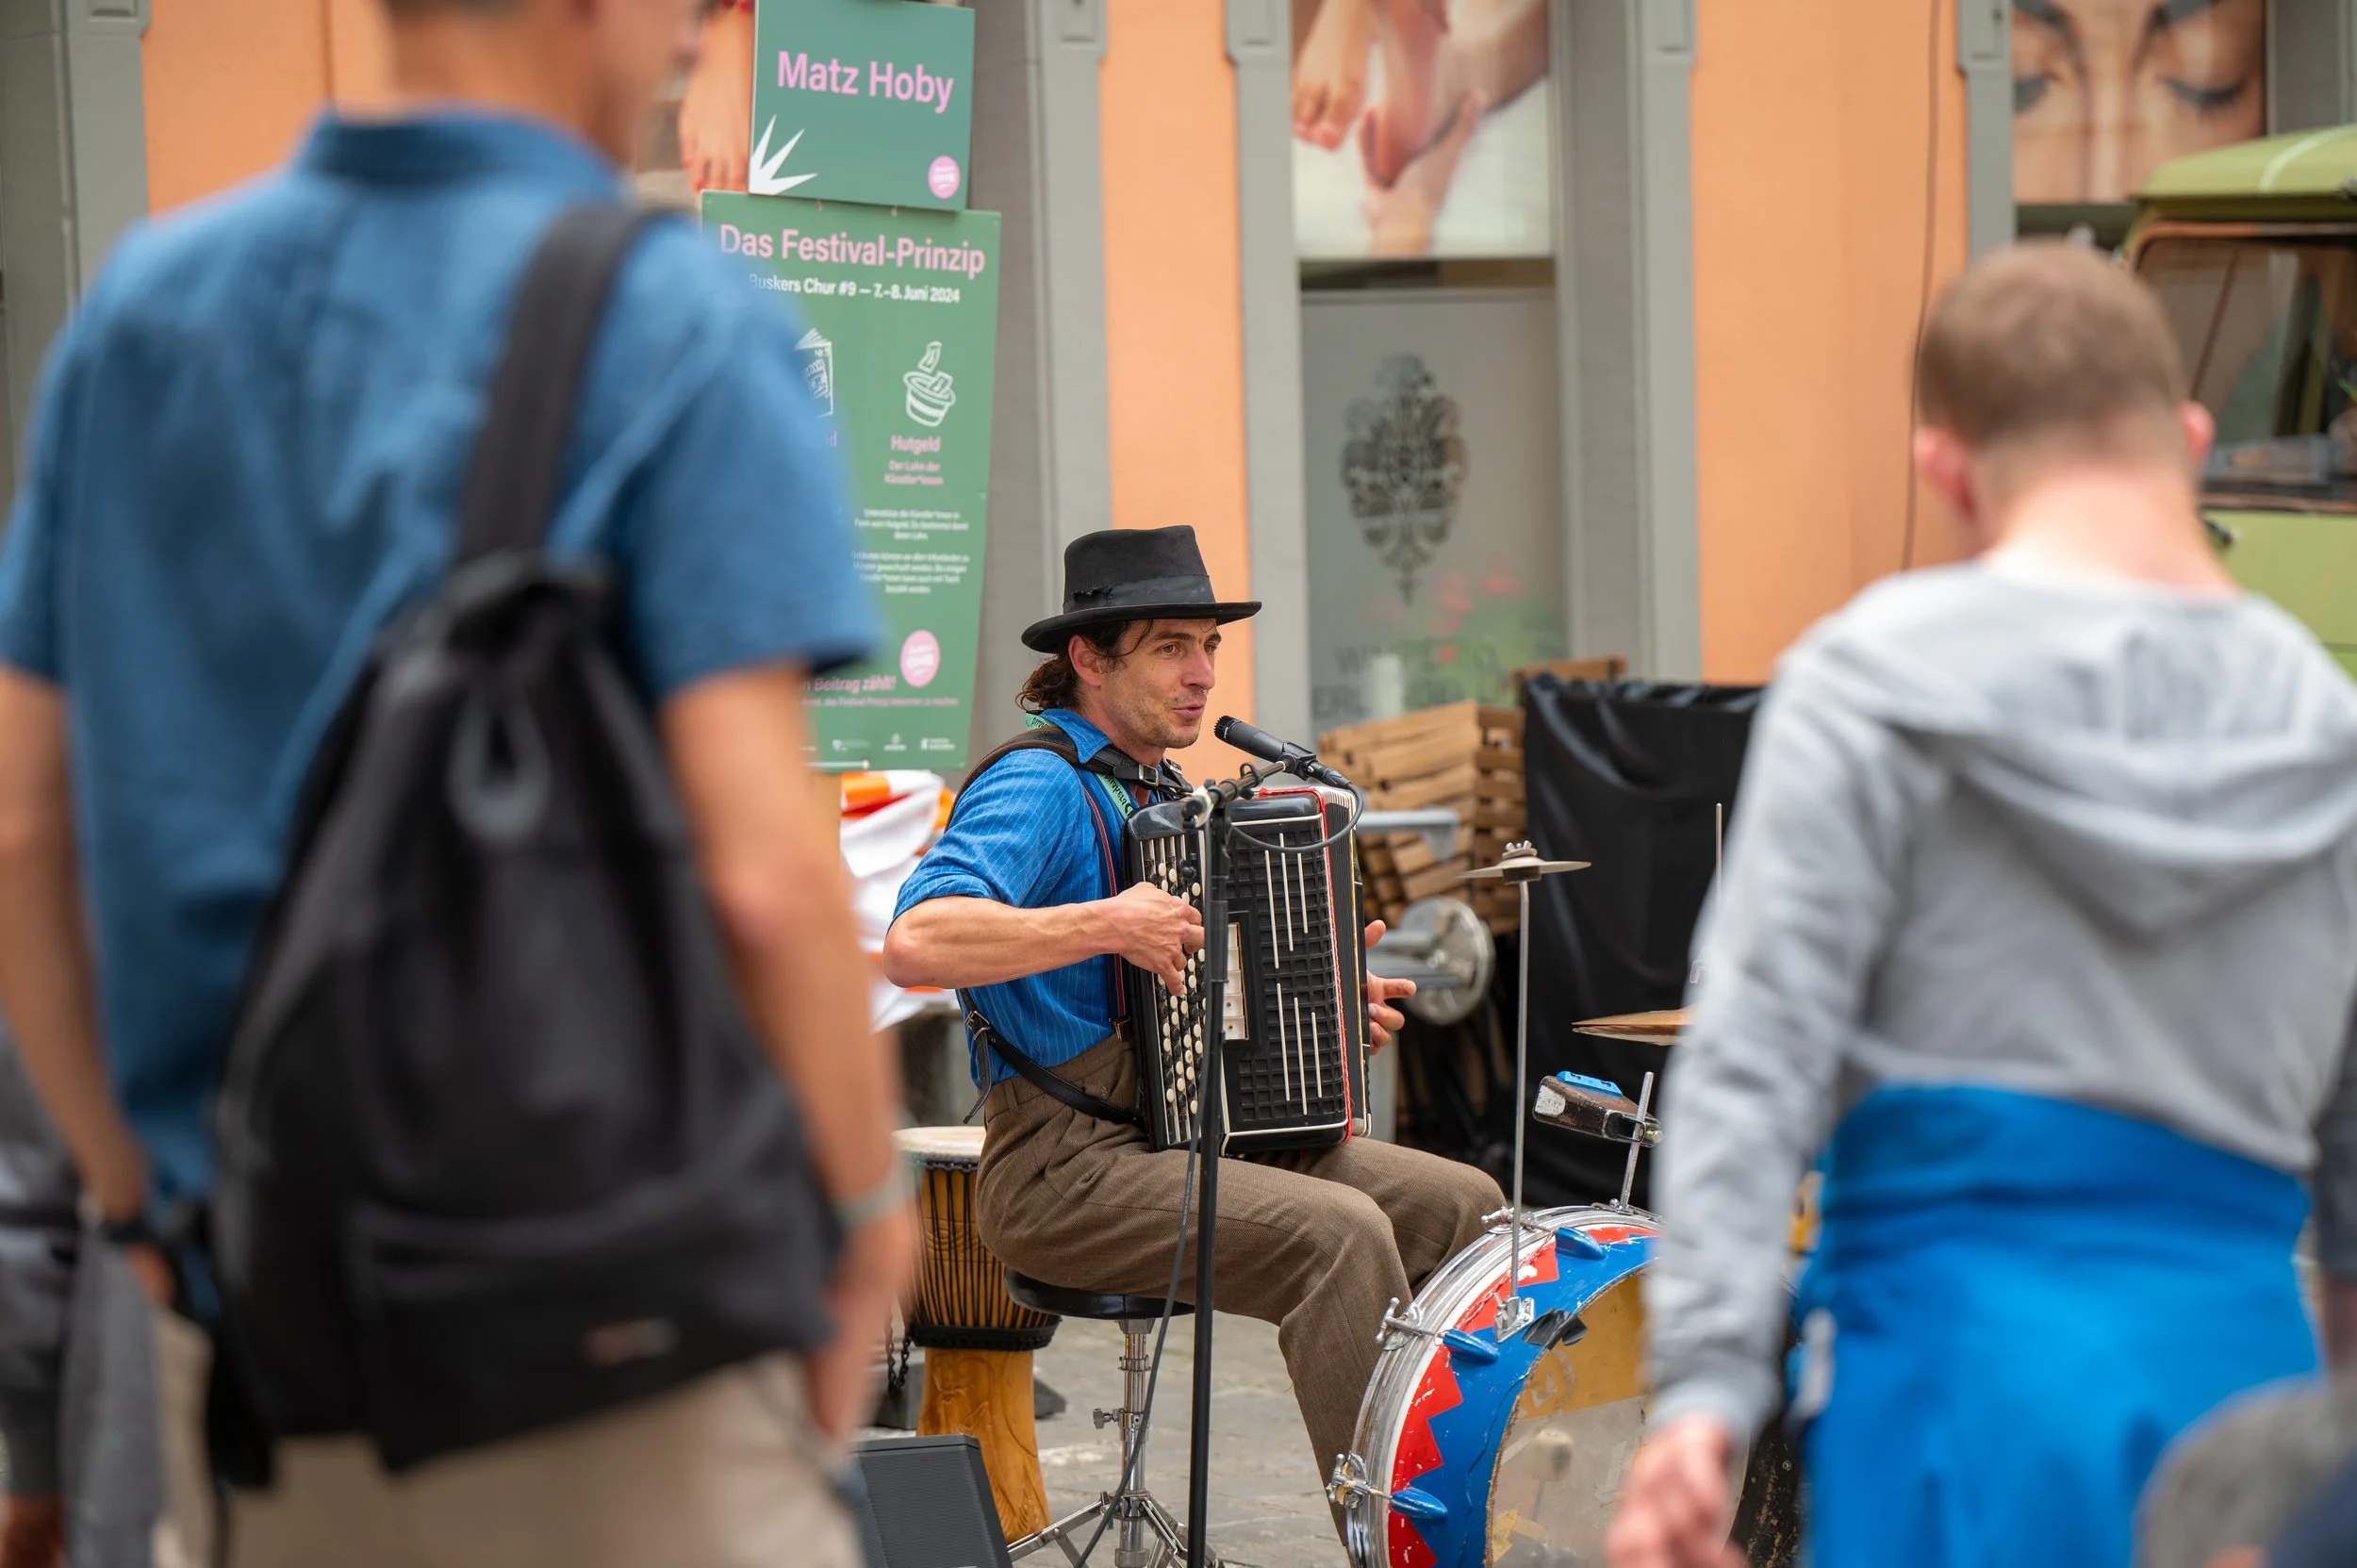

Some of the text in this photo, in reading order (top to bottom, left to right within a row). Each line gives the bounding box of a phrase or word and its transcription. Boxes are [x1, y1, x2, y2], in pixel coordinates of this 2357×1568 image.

[777, 51, 954, 114] Matz Hoby
[720, 224, 986, 280] Das Festival-Prinzip
[803, 278, 836, 296] Chur
[839, 281, 856, 296] #9
[930, 287, 960, 304] 2024
